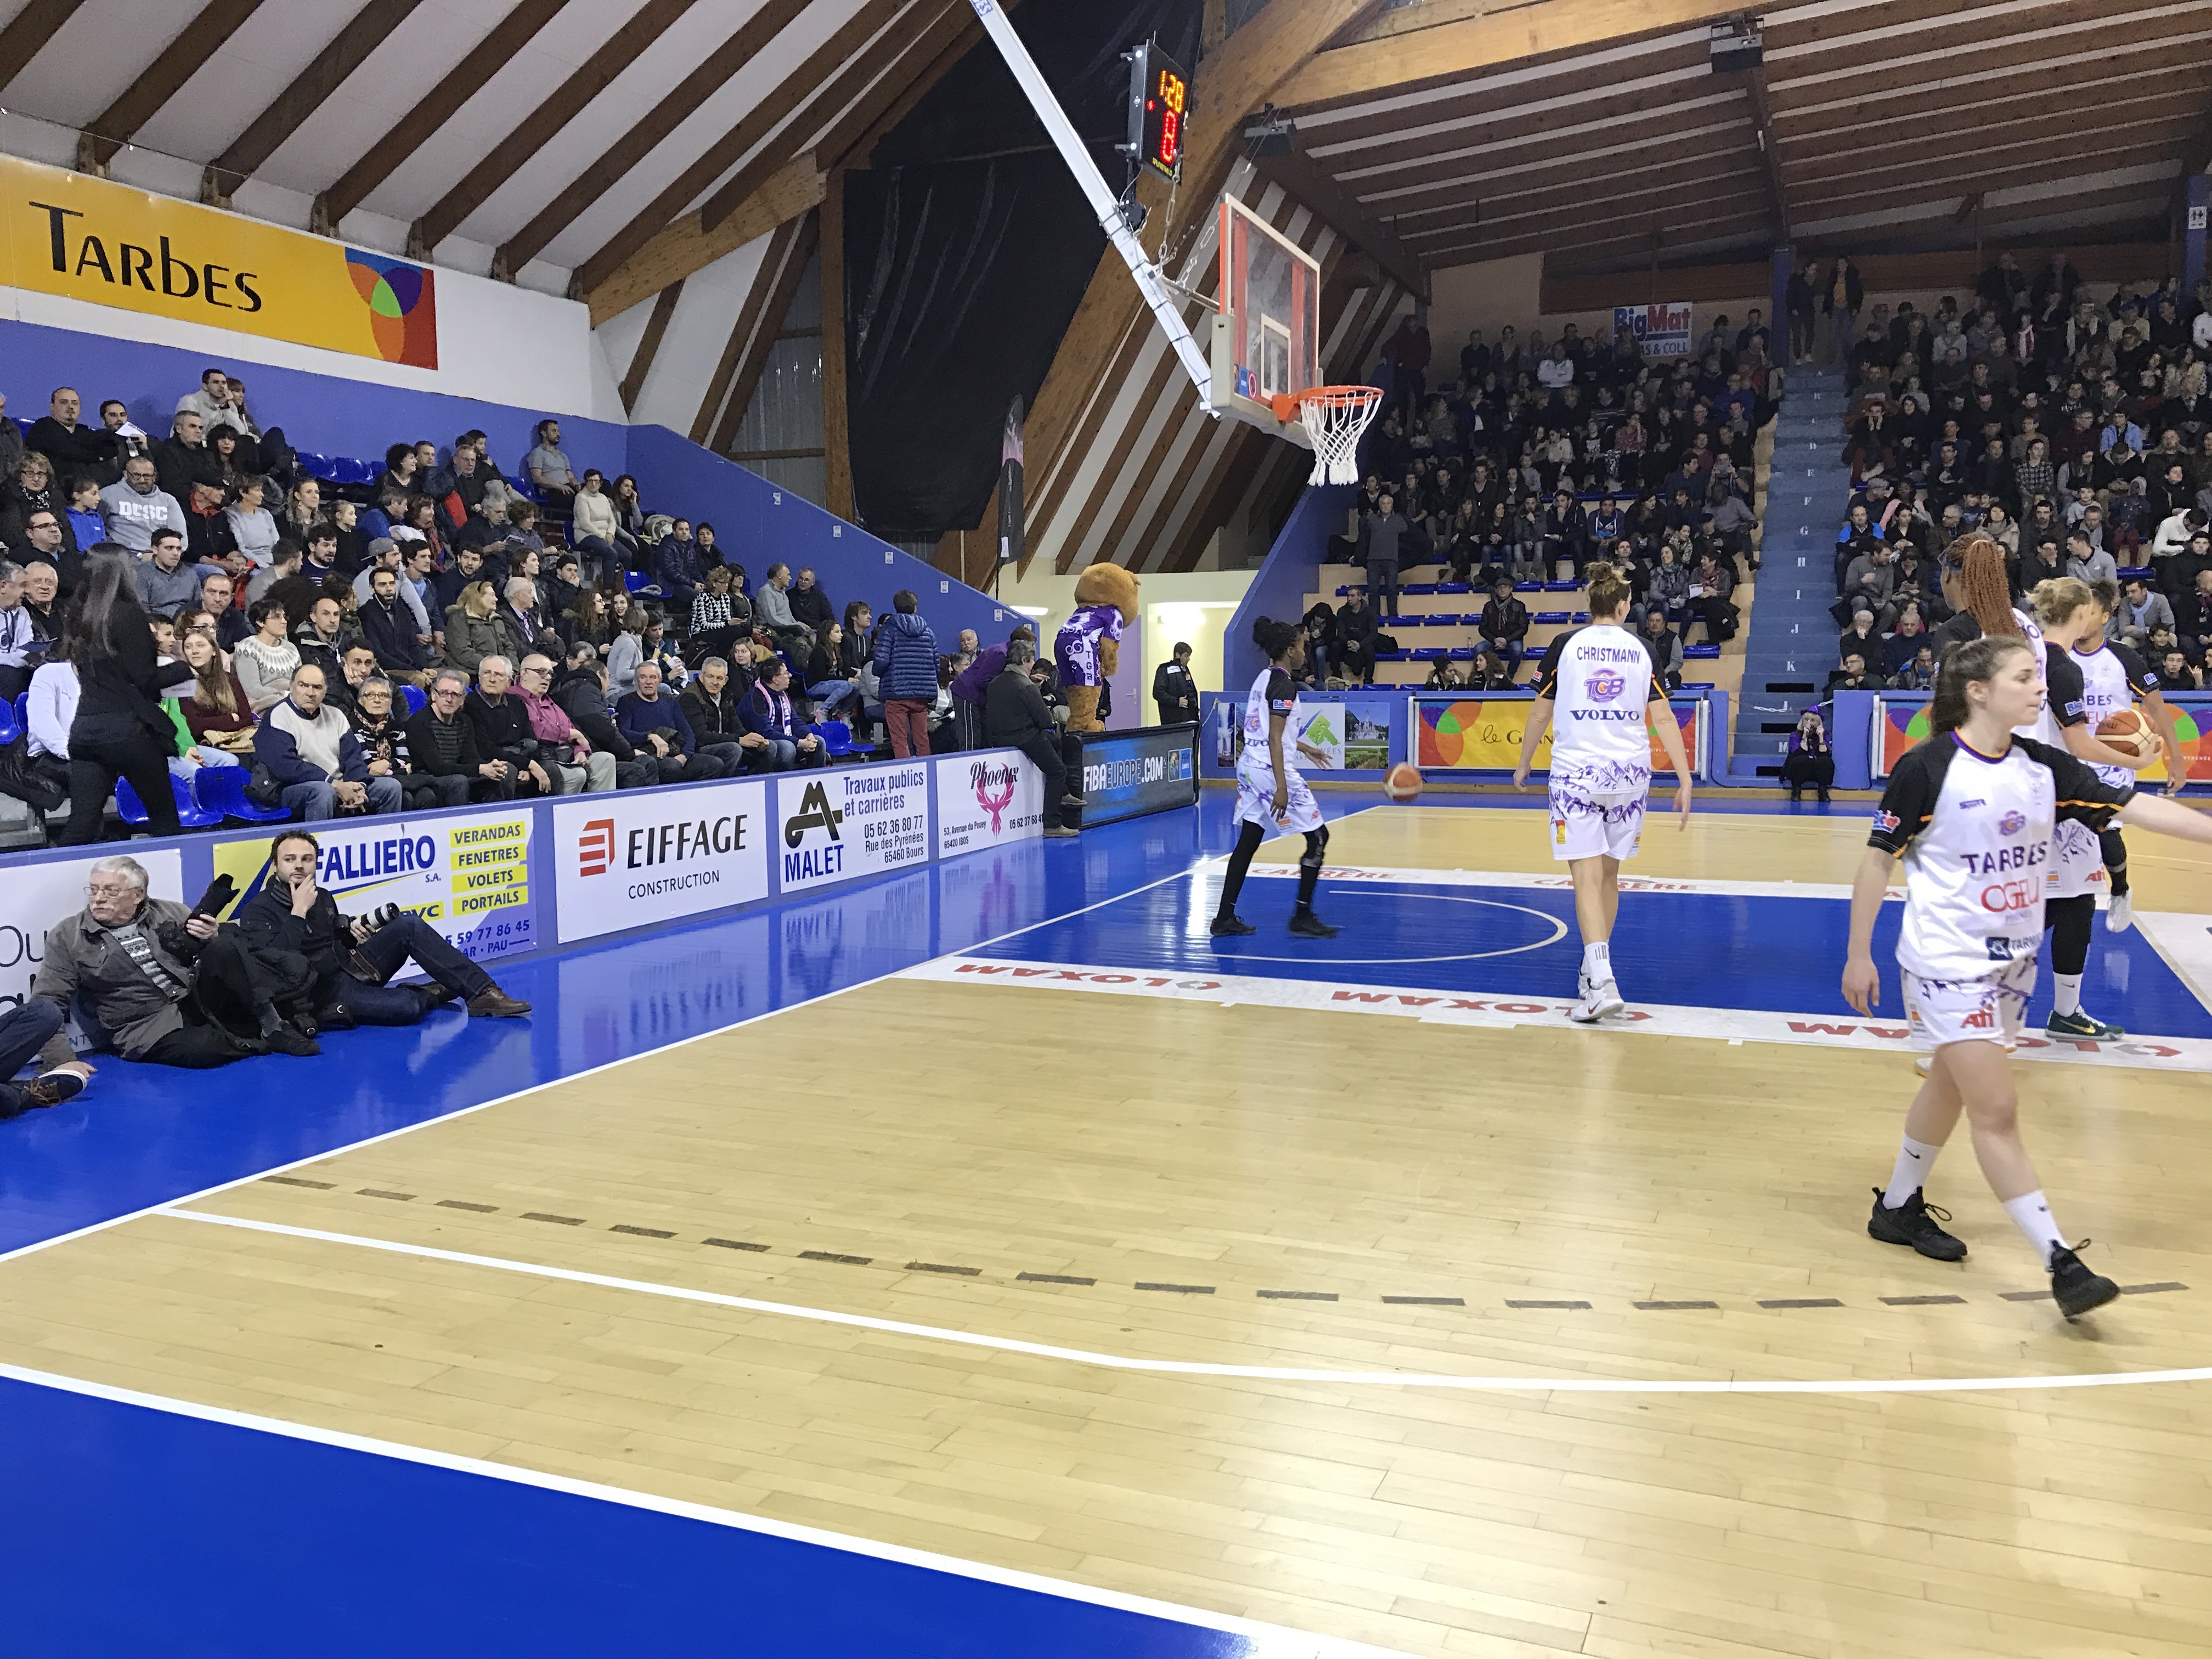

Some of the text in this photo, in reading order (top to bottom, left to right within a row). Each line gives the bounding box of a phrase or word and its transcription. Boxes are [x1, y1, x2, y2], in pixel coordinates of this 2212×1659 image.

[1800, 526, 1808, 535] G
[1797, 557, 1805, 567] H
[1791, 624, 1798, 633] J
[1577, 646, 1640, 664] CHRISTMANN
[1787, 661, 1796, 671] K
[2086, 695, 2112, 706] BES
[1570, 709, 1640, 721] VOLVO
[1481, 724, 1502, 743] le
[843, 769, 923, 795] Travaux publics
[970, 761, 1019, 789] Phoenix
[1083, 756, 1163, 793] FIBAEUROPE.COM
[844, 793, 905, 817] et carrières
[864, 815, 923, 838] 05 62 36 80 77
[952, 824, 967, 834] Avenue
[968, 822, 973, 831] du
[974, 820, 986, 830] Pouey
[1009, 819, 1015, 829] 05
[1017, 817, 1023, 827] 62
[1024, 816, 1030, 826] 37
[1031, 814, 1037, 825] 68
[454, 824, 521, 845] VERANDAS
[628, 814, 747, 869] EIFFAGE
[865, 831, 924, 853] Rue des Pyrénées
[944, 836, 969, 849] 65420 IBOS
[458, 847, 519, 866] FENETRES
[785, 844, 844, 883] MALET
[884, 846, 924, 864] 65460 Bours
[1960, 841, 2048, 874] TARBES
[425, 873, 441, 883] S.A.
[467, 870, 513, 888] VOLETS
[628, 870, 720, 899] CONSTRUCTION
[462, 891, 519, 912] PORTAILS
[445, 919, 530, 945] 5 59 77 86 45
[487, 939, 507, 953] PAU
[953, 964, 1173, 988] LOXAM
